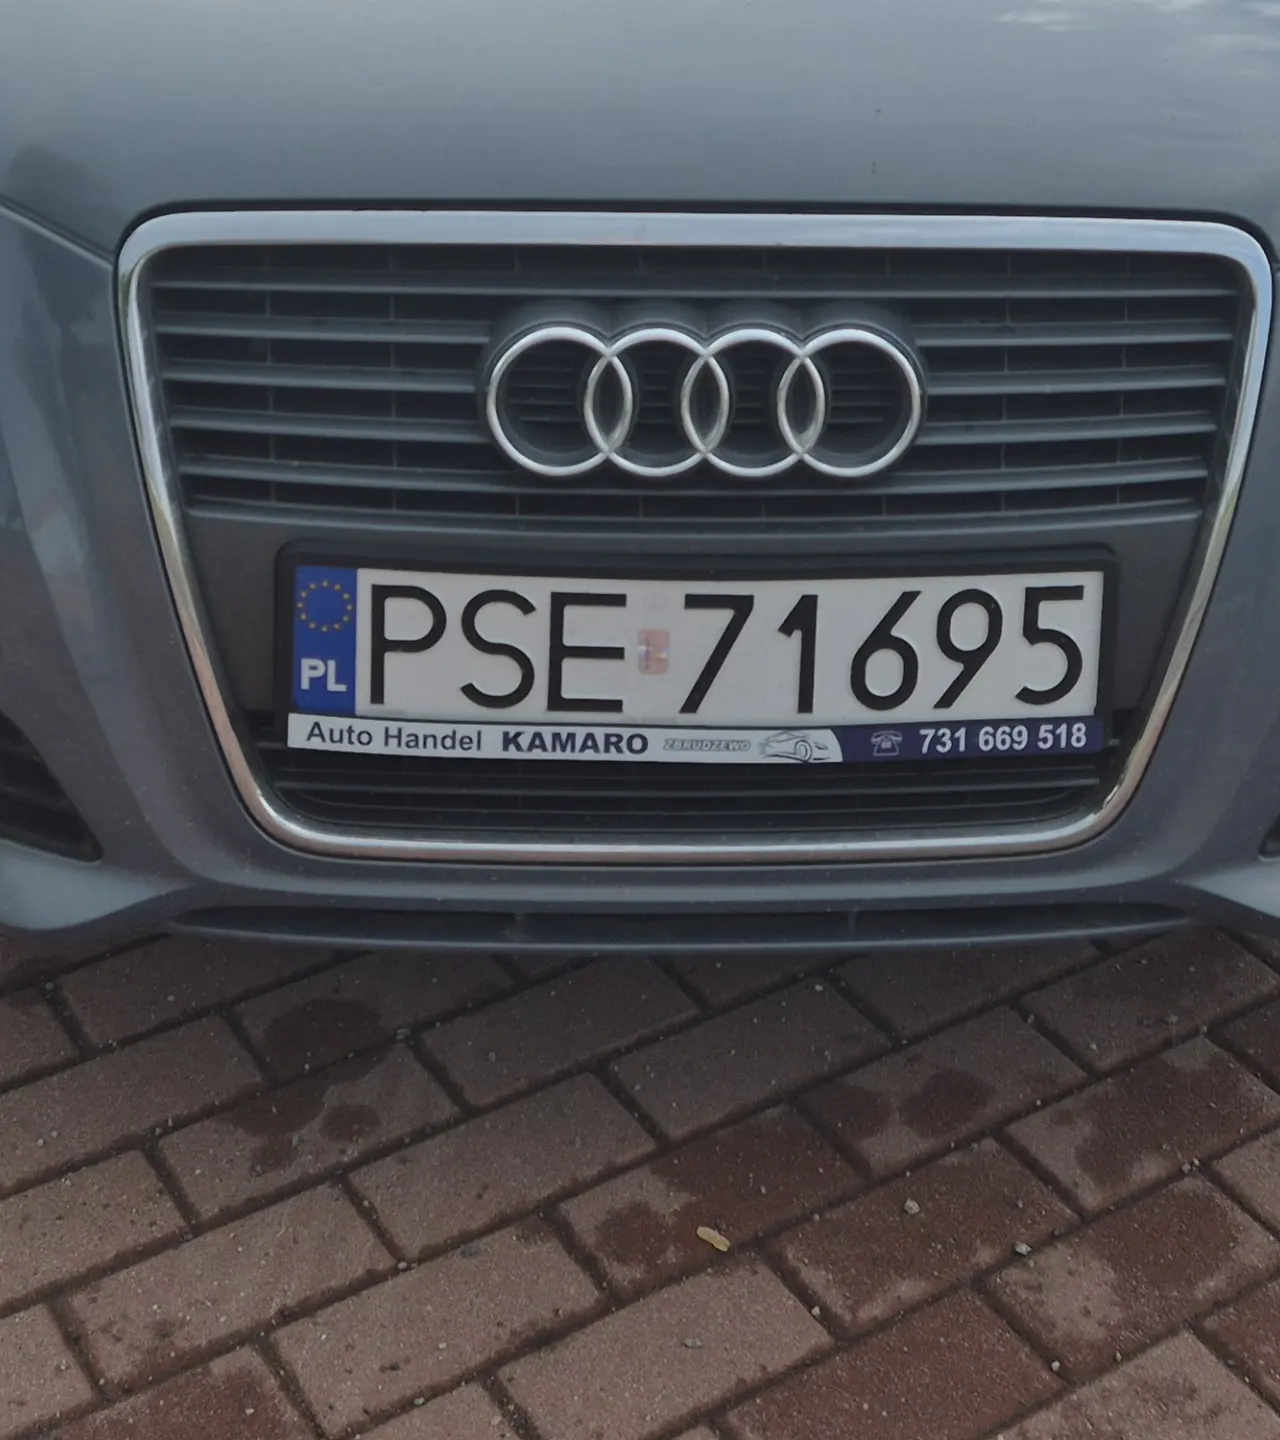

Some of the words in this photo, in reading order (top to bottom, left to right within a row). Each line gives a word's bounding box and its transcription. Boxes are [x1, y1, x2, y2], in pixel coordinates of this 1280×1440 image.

[370, 583, 628, 714] PSE
[678, 584, 1085, 715] 71695
[300, 658, 348, 693] PL
[306, 721, 373, 747] Auto
[383, 726, 482, 752] Handel
[502, 731, 649, 755] KAMARO
[663, 738, 752, 752] ZBRUDZEWO
[920, 727, 968, 754] 731
[977, 724, 1029, 752] 669
[1037, 722, 1088, 750] 518
